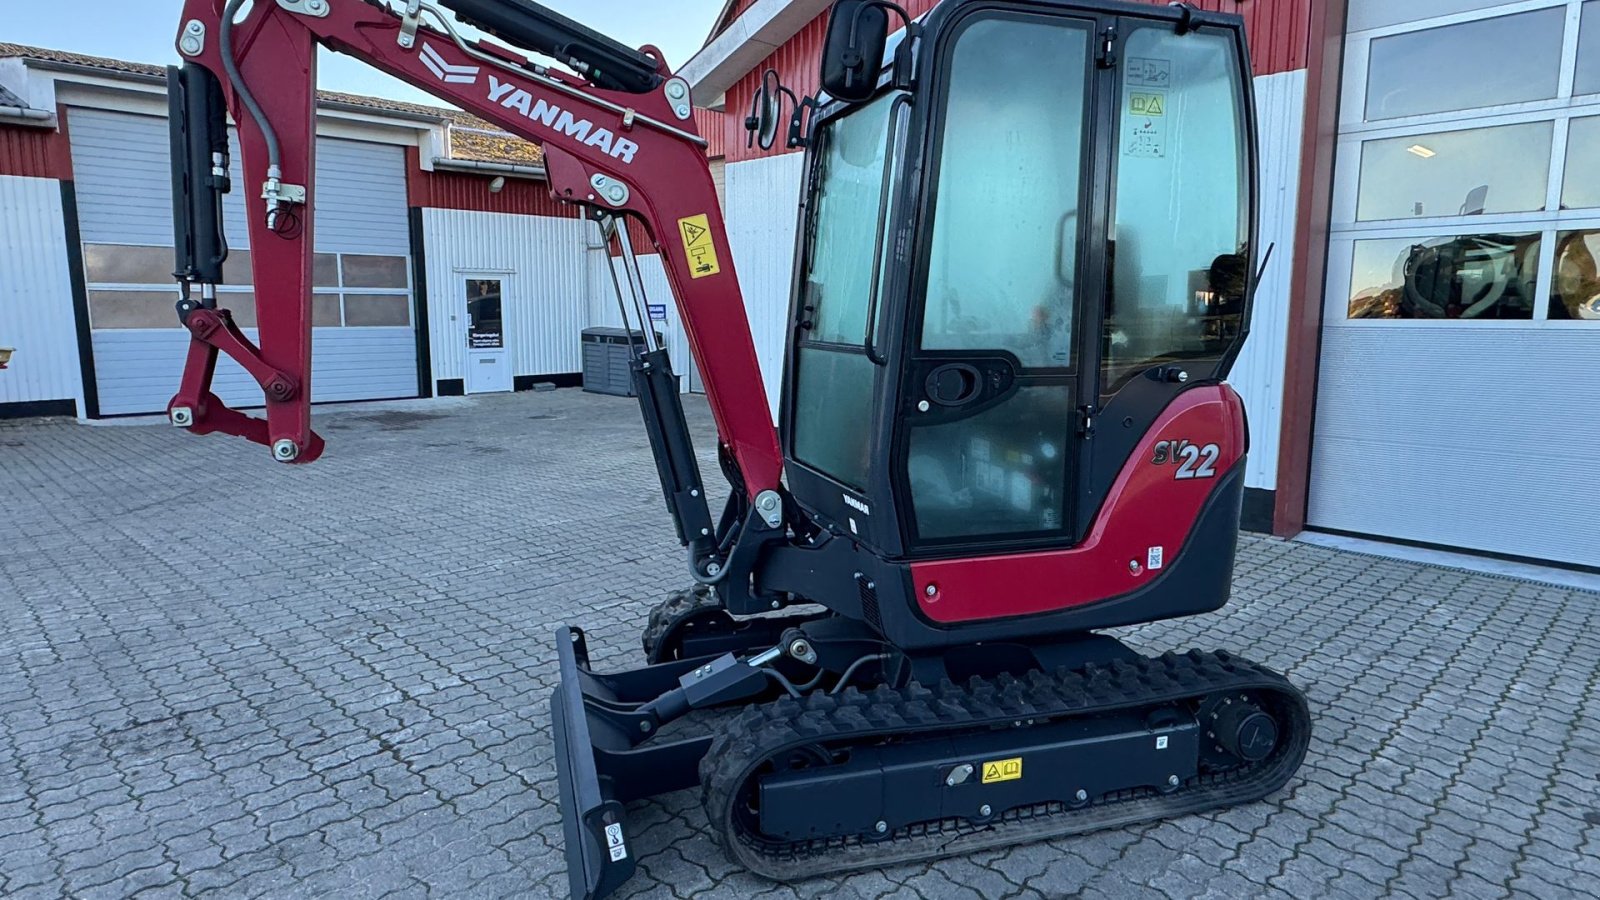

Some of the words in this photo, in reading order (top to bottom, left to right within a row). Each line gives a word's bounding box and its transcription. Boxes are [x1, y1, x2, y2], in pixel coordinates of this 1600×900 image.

[487, 74, 639, 165] YANMAR
[1151, 438, 1220, 480] SV22
[842, 493, 870, 516] YANMAR
